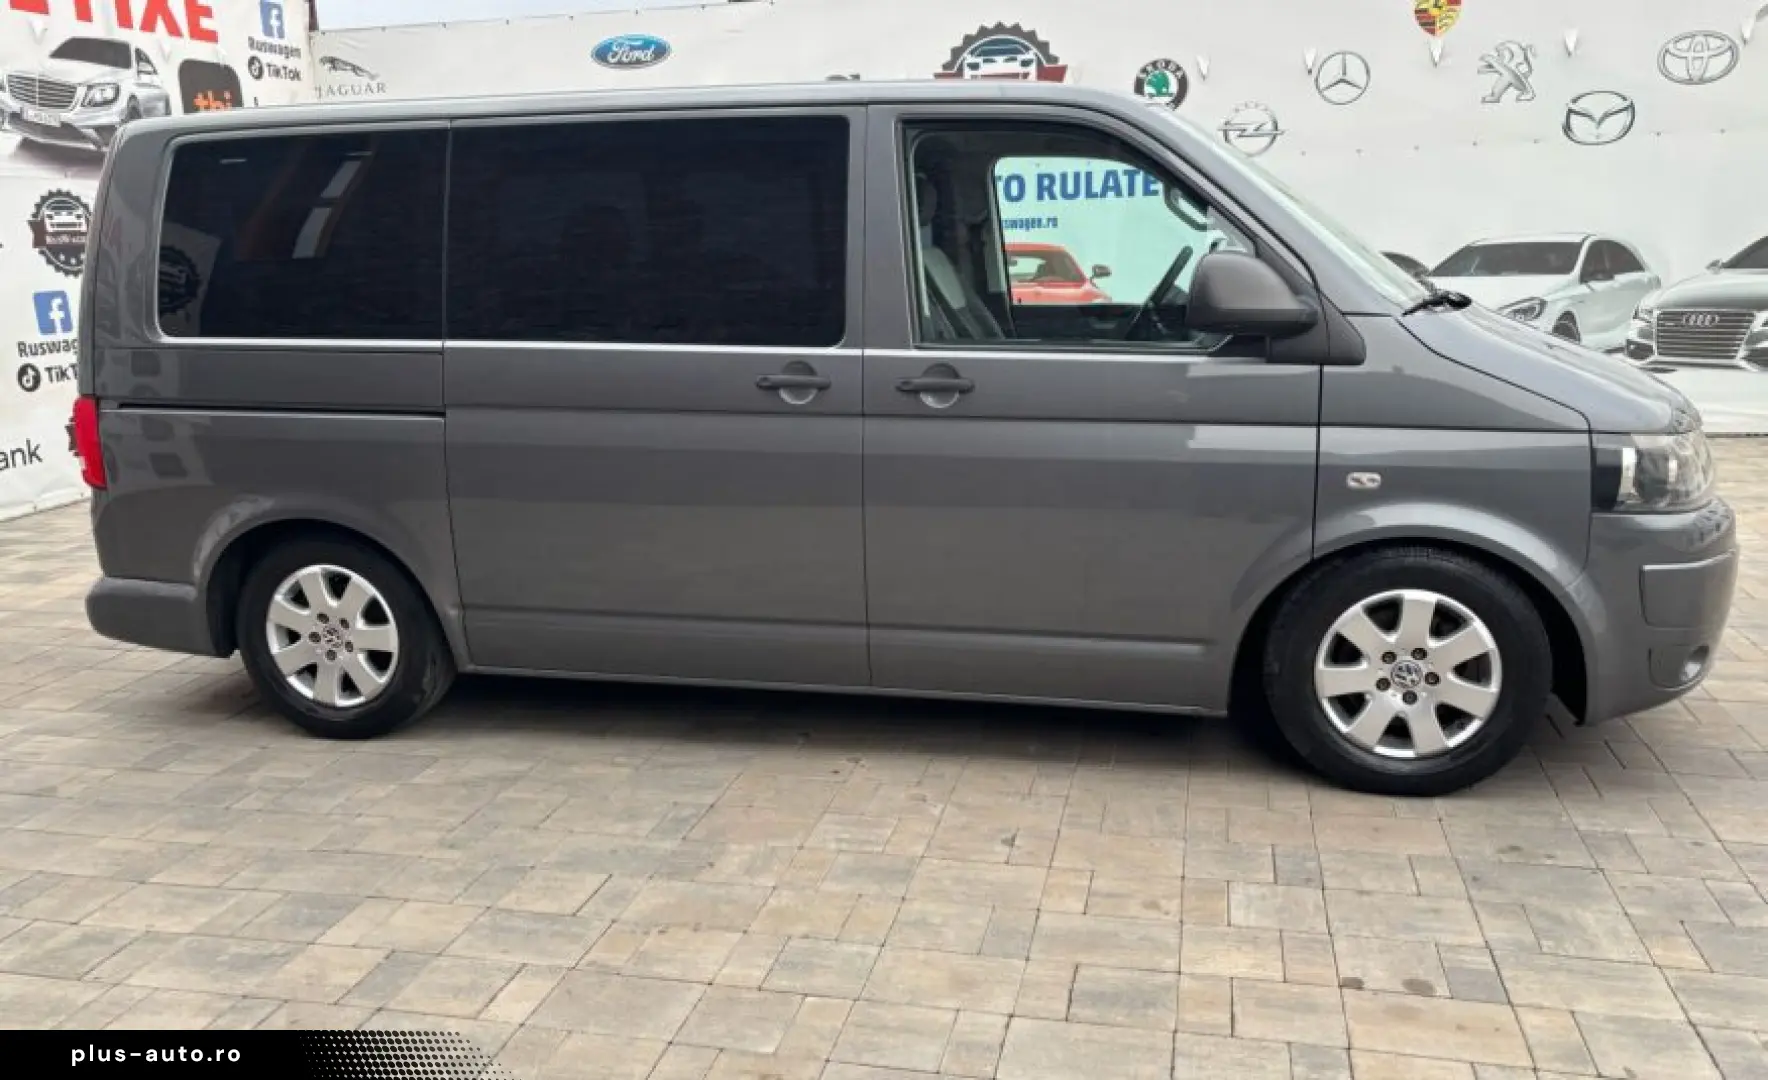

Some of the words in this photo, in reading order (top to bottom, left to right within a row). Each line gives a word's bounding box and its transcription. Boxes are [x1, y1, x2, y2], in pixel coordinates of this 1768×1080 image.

[607, 41, 655, 63] Ford
[266, 62, 302, 81] TikTok
[315, 81, 387, 100] JAGUAR
[1036, 168, 1159, 201] RULATE
